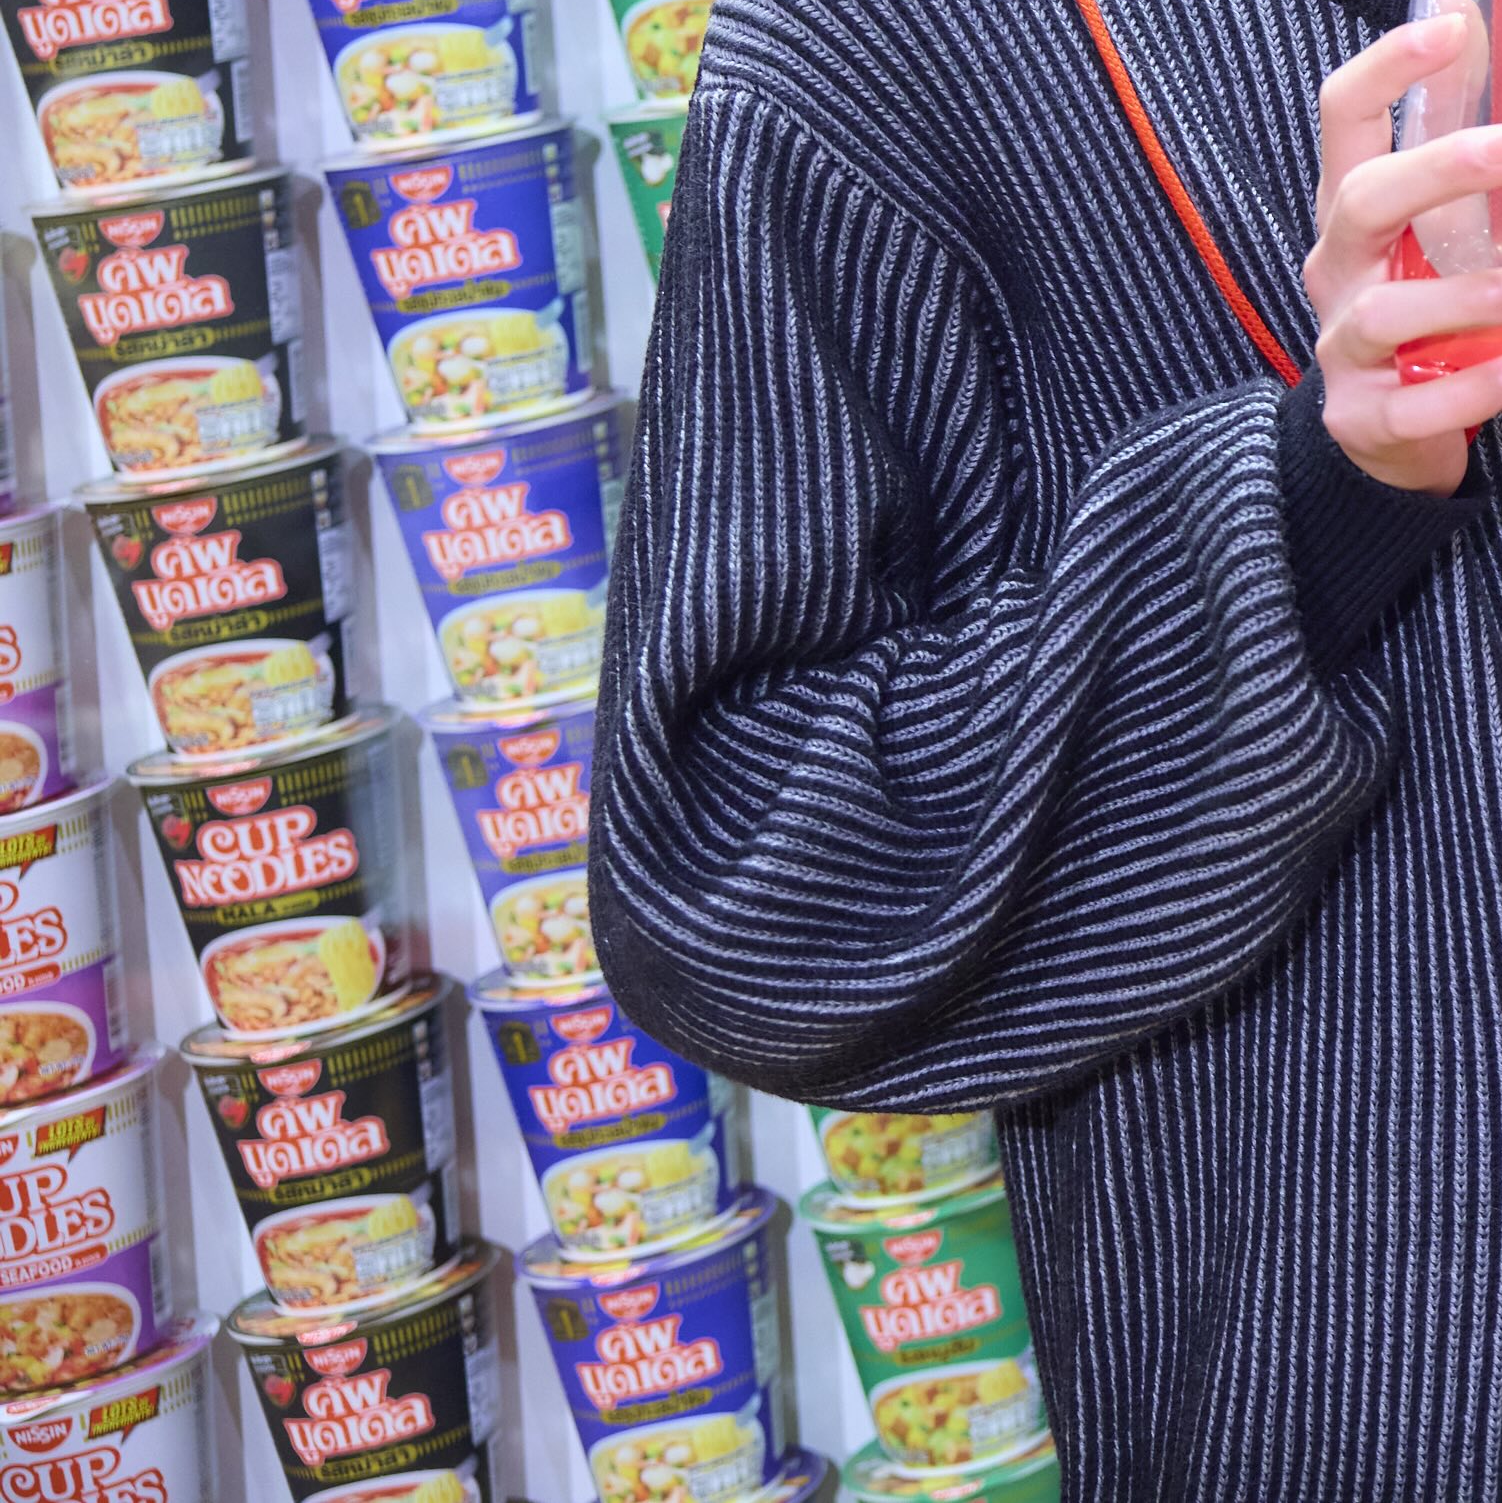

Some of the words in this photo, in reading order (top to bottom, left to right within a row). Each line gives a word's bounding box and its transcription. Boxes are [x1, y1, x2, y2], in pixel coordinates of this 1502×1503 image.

[198, 807, 317, 862] CUP
[175, 830, 358, 904] NOODLES
[0, 1162, 67, 1217] UP
[0, 1188, 115, 1263] DLES
[14, 1423, 67, 1446] NISSIN
[2, 1444, 121, 1503] CUP
